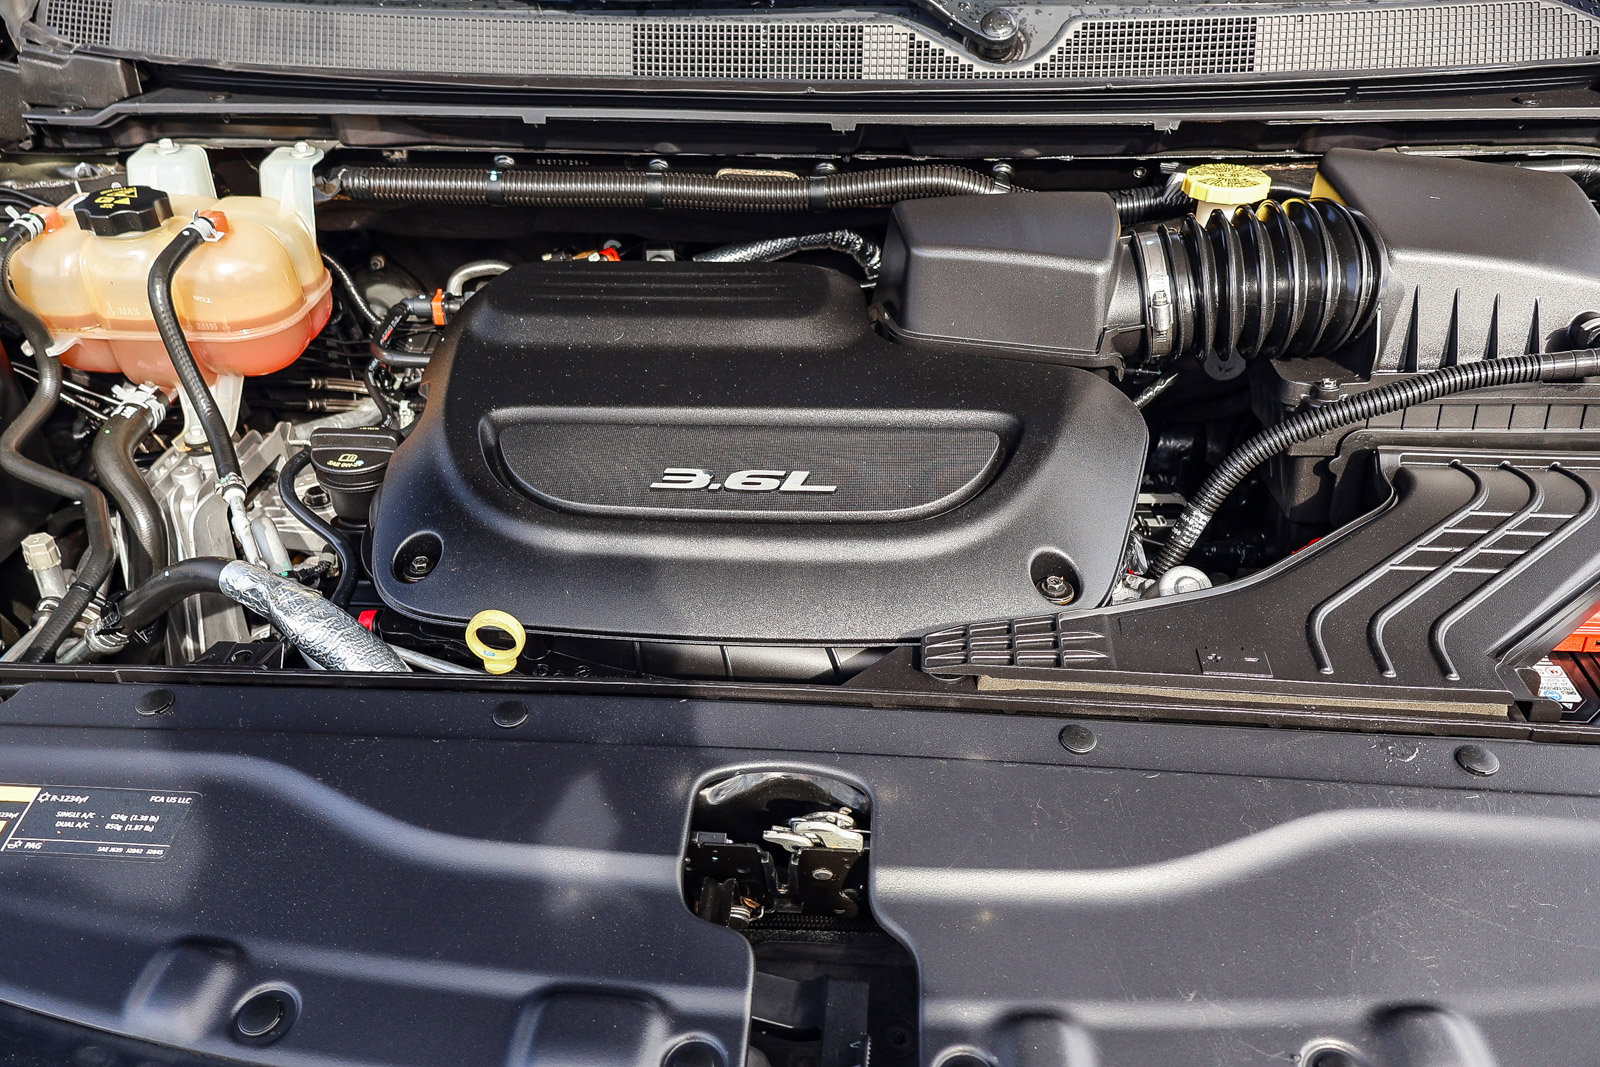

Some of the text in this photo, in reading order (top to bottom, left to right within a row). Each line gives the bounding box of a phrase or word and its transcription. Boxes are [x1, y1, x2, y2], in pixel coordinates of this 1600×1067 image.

[650, 468, 837, 492] 3.6L
[49, 793, 90, 804] R-1234yf
[149, 795, 165, 803] FCA
[165, 796, 177, 804] US
[55, 811, 81, 819] SINGLE
[80, 812, 96, 820] A/C
[55, 820, 75, 828] DUAL
[75, 821, 90, 829] A/C
[104, 823, 123, 831] 850g
